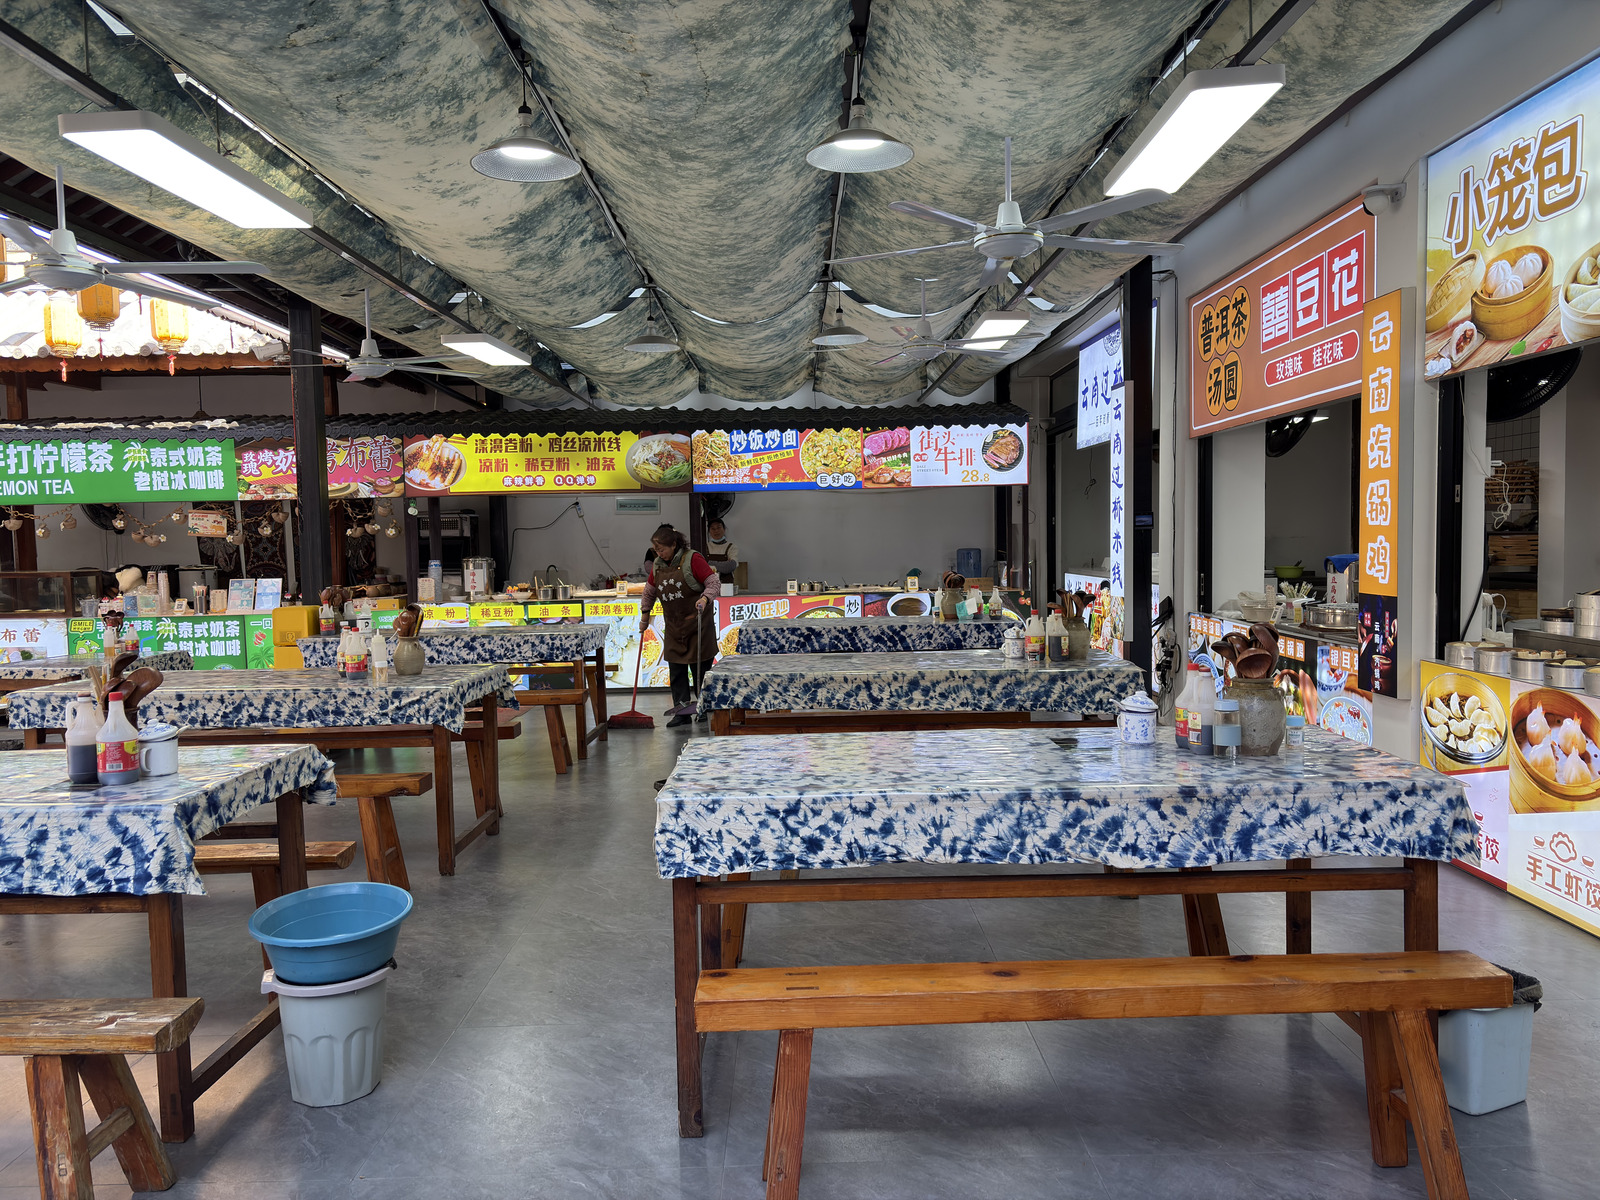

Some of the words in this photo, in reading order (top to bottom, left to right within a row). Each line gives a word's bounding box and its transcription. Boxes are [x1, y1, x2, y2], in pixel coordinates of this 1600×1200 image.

[1443, 115, 1588, 259] 小笼包
[1200, 291, 1248, 356] 普洱茶
[1275, 355, 1303, 380] 玫瑰味
[1312, 338, 1344, 369] 桂花味
[1208, 358, 1238, 407] 汤圆
[732, 429, 797, 452] 炒饭炒面
[1366, 311, 1393, 584] 云南汽锅鸡
[149, 446, 222, 467] 泰式奶茶
[243, 453, 260, 475] 玫瑰
[133, 469, 225, 491] 老挝冰咖啡
[503, 476, 545, 487] 麻辣鲜香
[554, 475, 596, 486] QQ弹弹
[961, 469, 990, 483] 28.8
[0, 479, 39, 496] MON
[42, 479, 75, 495] TEA
[1111, 398, 1124, 590] 云南过桥米线
[481, 607, 514, 618] 稀豆粉
[539, 605, 571, 617] 油条
[730, 599, 789, 622] 猛火旺炒
[178, 620, 240, 638] 泰式奶茶
[1526, 854, 1600, 910] 手工虾饺
